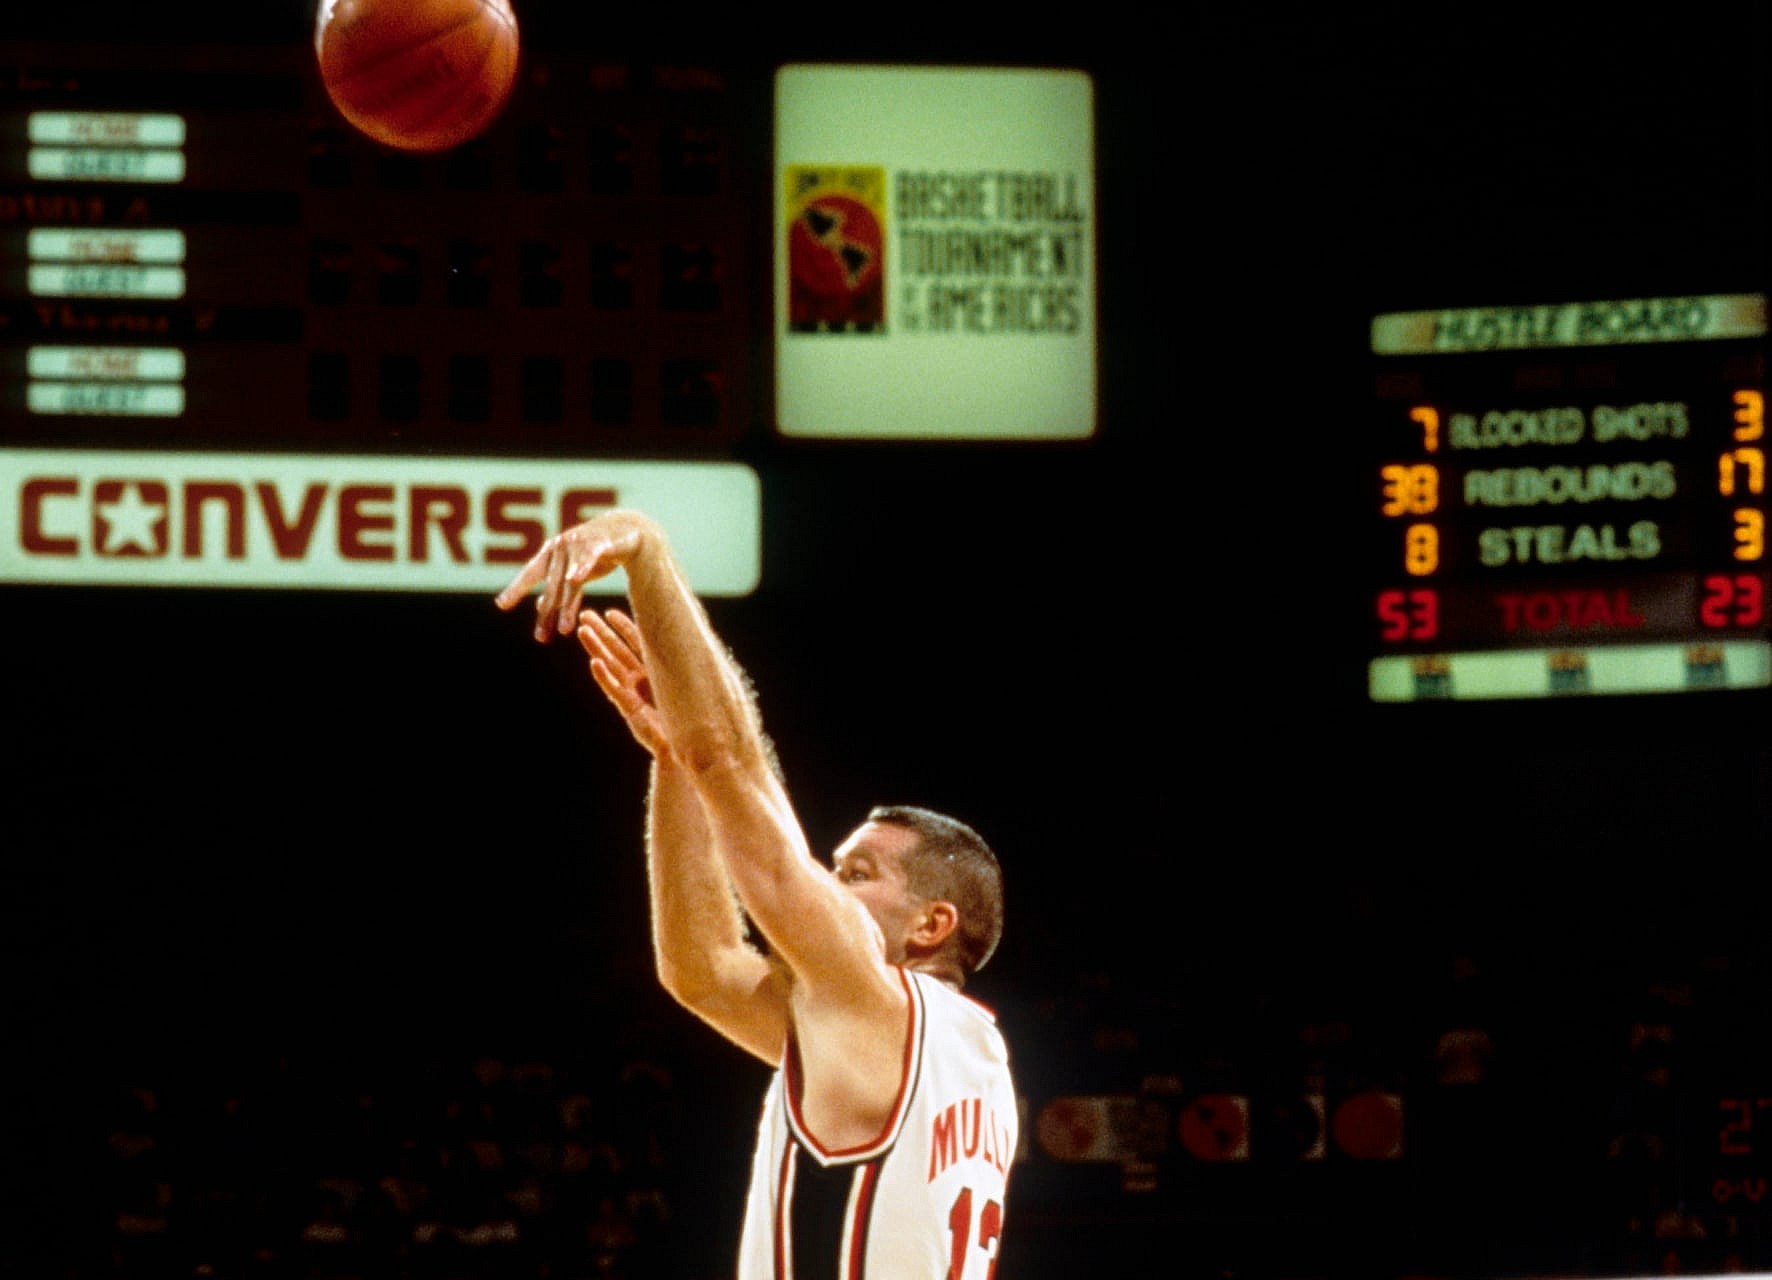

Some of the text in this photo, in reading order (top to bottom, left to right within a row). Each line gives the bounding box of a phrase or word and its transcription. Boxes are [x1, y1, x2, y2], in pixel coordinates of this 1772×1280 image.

[895, 170, 1084, 223] BASKETBALL
[900, 228, 1084, 277] TOURNAMENT
[1448, 408, 1585, 449] BLOCKED
[1592, 402, 1689, 442] SHOTS
[1732, 389, 1764, 442] 3
[1381, 464, 1439, 517] 38
[1464, 460, 1677, 507] REBOUNDS
[1405, 507, 1764, 576] 8 STEALS 3
[1376, 574, 1764, 641] 53 TOTAL 23
